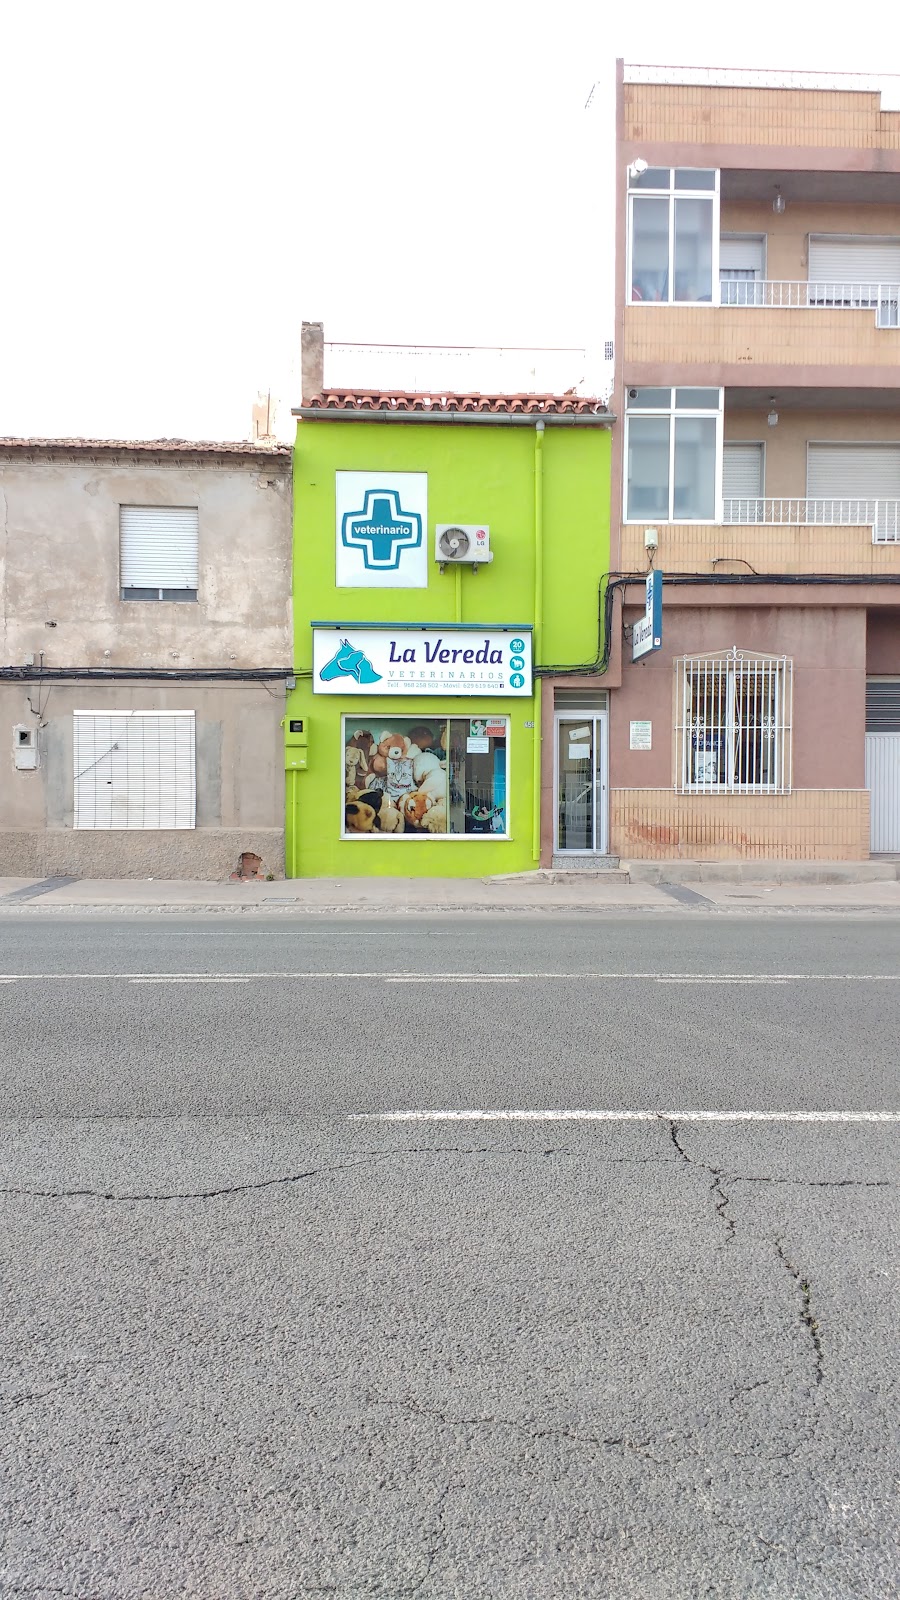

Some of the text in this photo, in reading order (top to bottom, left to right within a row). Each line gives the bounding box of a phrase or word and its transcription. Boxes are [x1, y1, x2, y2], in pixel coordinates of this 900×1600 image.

[354, 525, 410, 535] veterinario
[389, 639, 503, 664] La Vereda
[389, 671, 504, 679] VETERINARIOS
